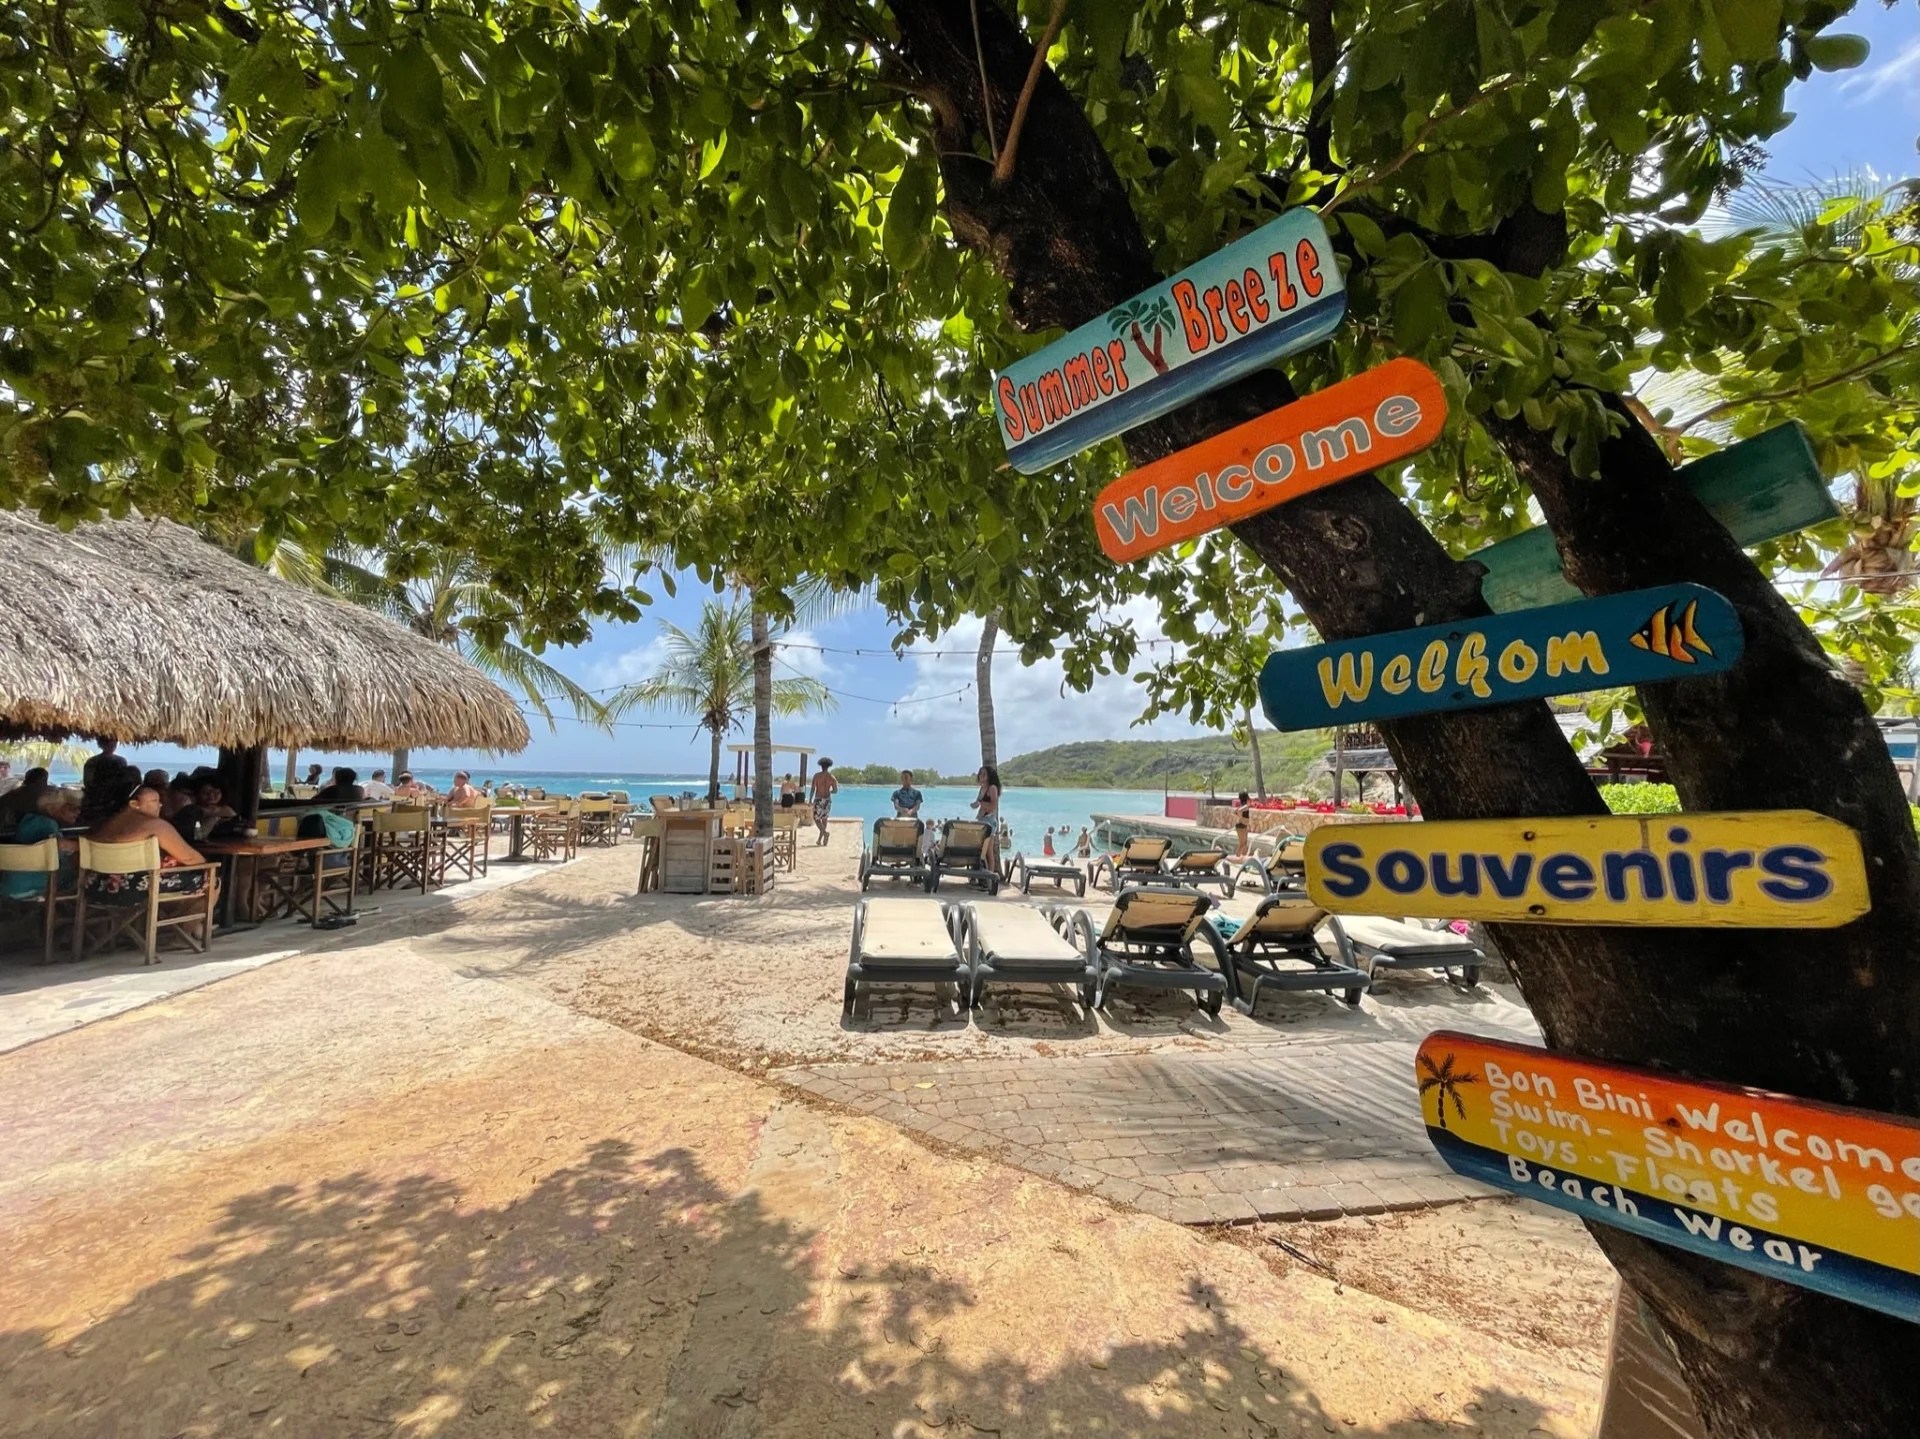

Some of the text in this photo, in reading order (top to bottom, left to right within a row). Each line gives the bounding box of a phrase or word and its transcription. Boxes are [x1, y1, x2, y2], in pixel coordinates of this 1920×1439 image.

[998, 238, 1324, 442] Summer Breeze
[1102, 395, 1423, 546] Welcome
[1317, 630, 1610, 709] Welkom
[1320, 826, 1834, 905] Souvenirs
[1484, 1062, 1557, 1099] Bon
[1573, 1077, 1655, 1121] Bini
[1490, 1116, 1579, 1165] Toys
[1644, 1126, 1842, 1201] Snorkel
[1508, 1154, 1823, 1273] Beach Wear
